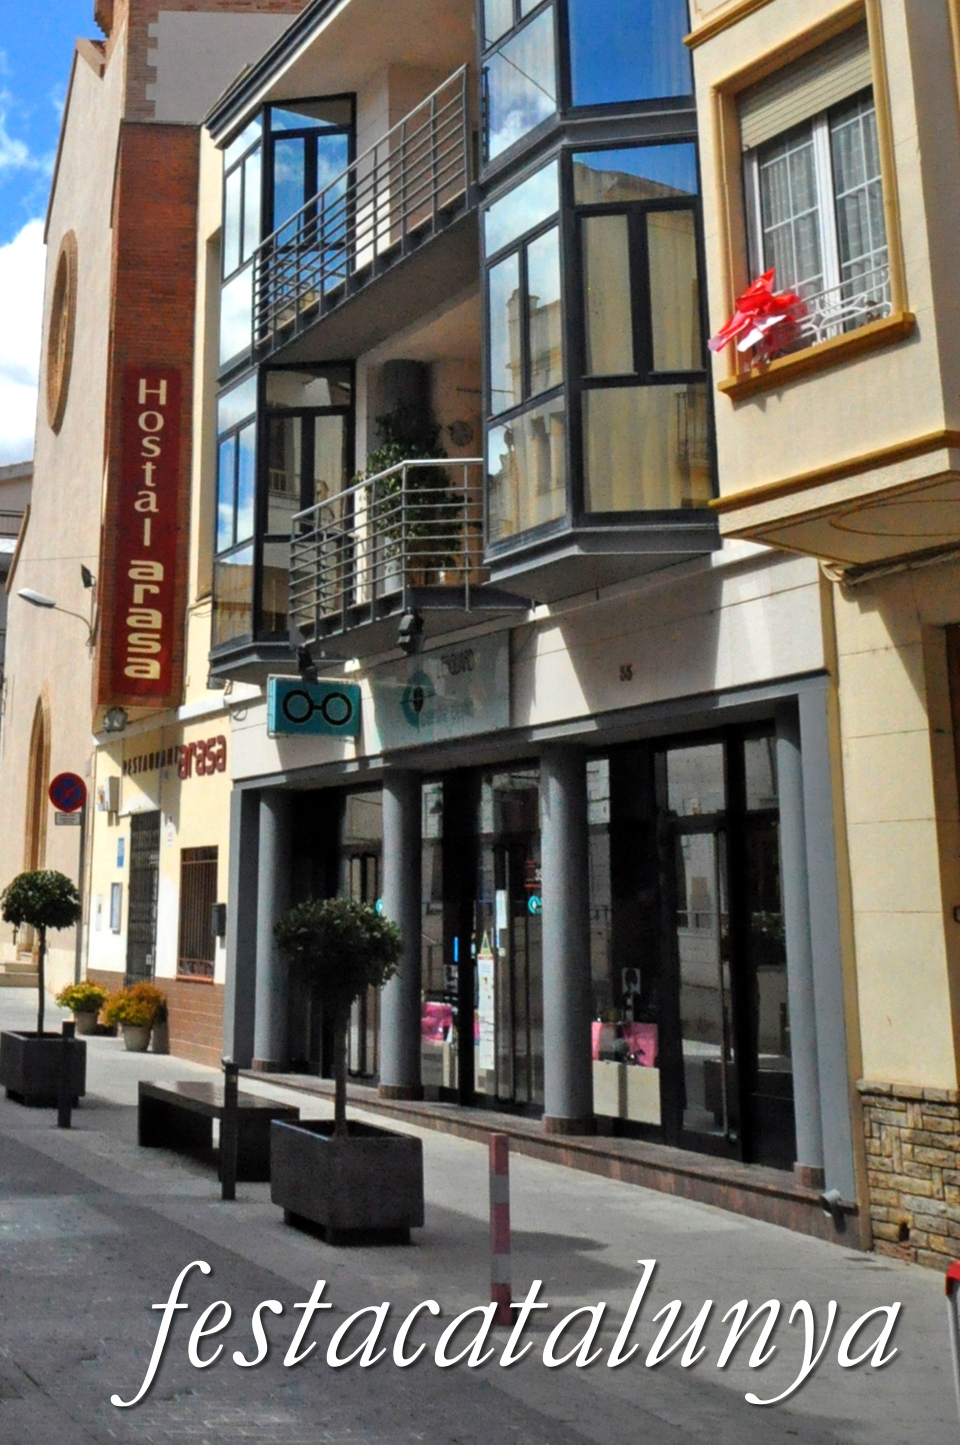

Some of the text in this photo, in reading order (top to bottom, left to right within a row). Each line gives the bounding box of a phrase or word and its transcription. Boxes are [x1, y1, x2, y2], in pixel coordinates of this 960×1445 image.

[124, 378, 167, 680] Hostal arasa
[178, 734, 227, 780] arasa
